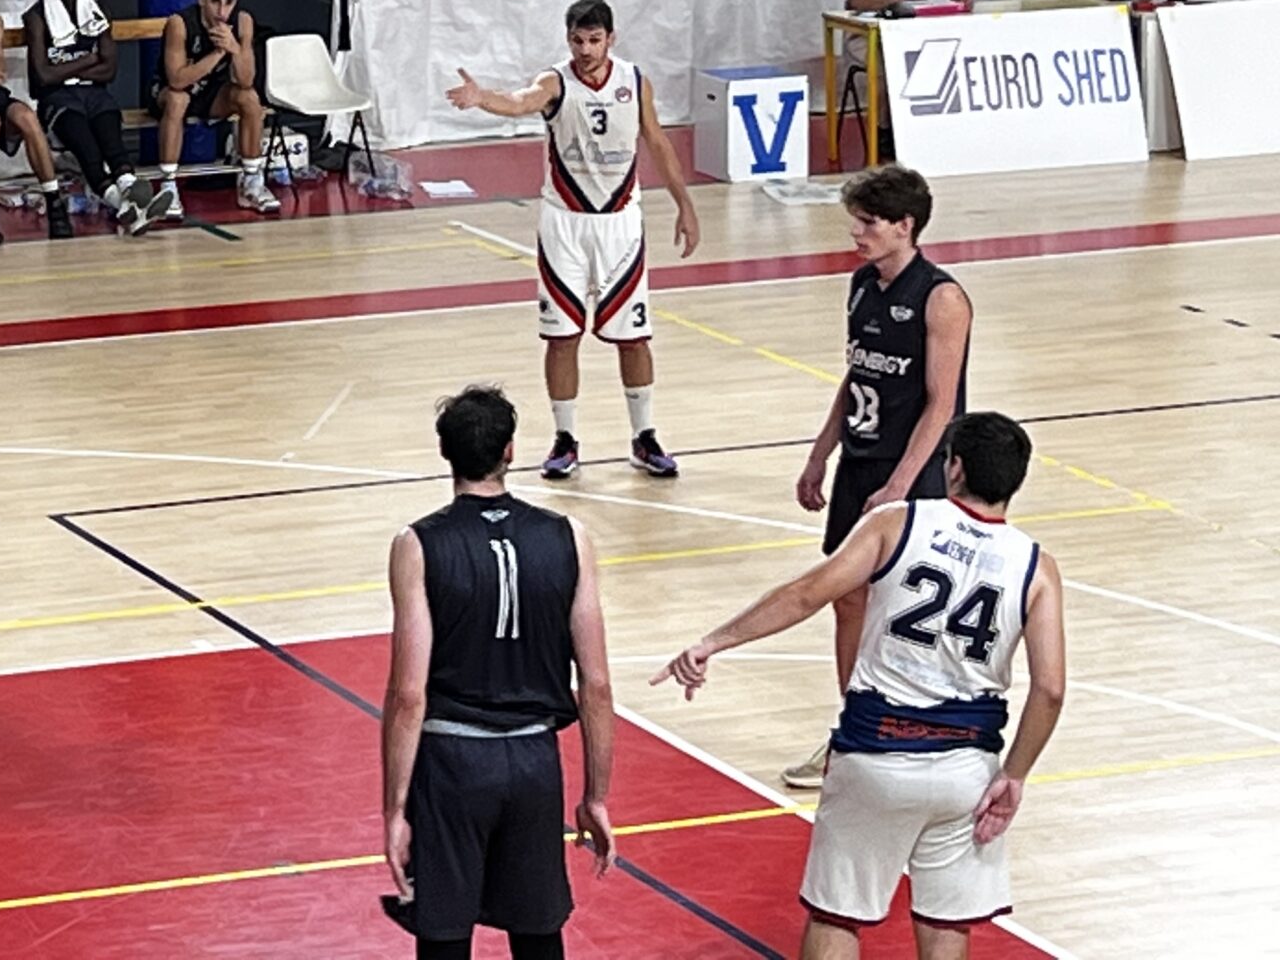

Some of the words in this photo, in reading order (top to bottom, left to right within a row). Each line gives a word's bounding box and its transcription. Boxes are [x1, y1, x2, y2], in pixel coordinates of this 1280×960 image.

[964, 52, 1043, 111] EURO
[1053, 48, 1132, 106] SHED
[591, 108, 608, 135] 3
[732, 90, 805, 174] V
[631, 301, 647, 328] 3
[489, 538, 521, 641] 11
[886, 561, 1004, 666] 24
